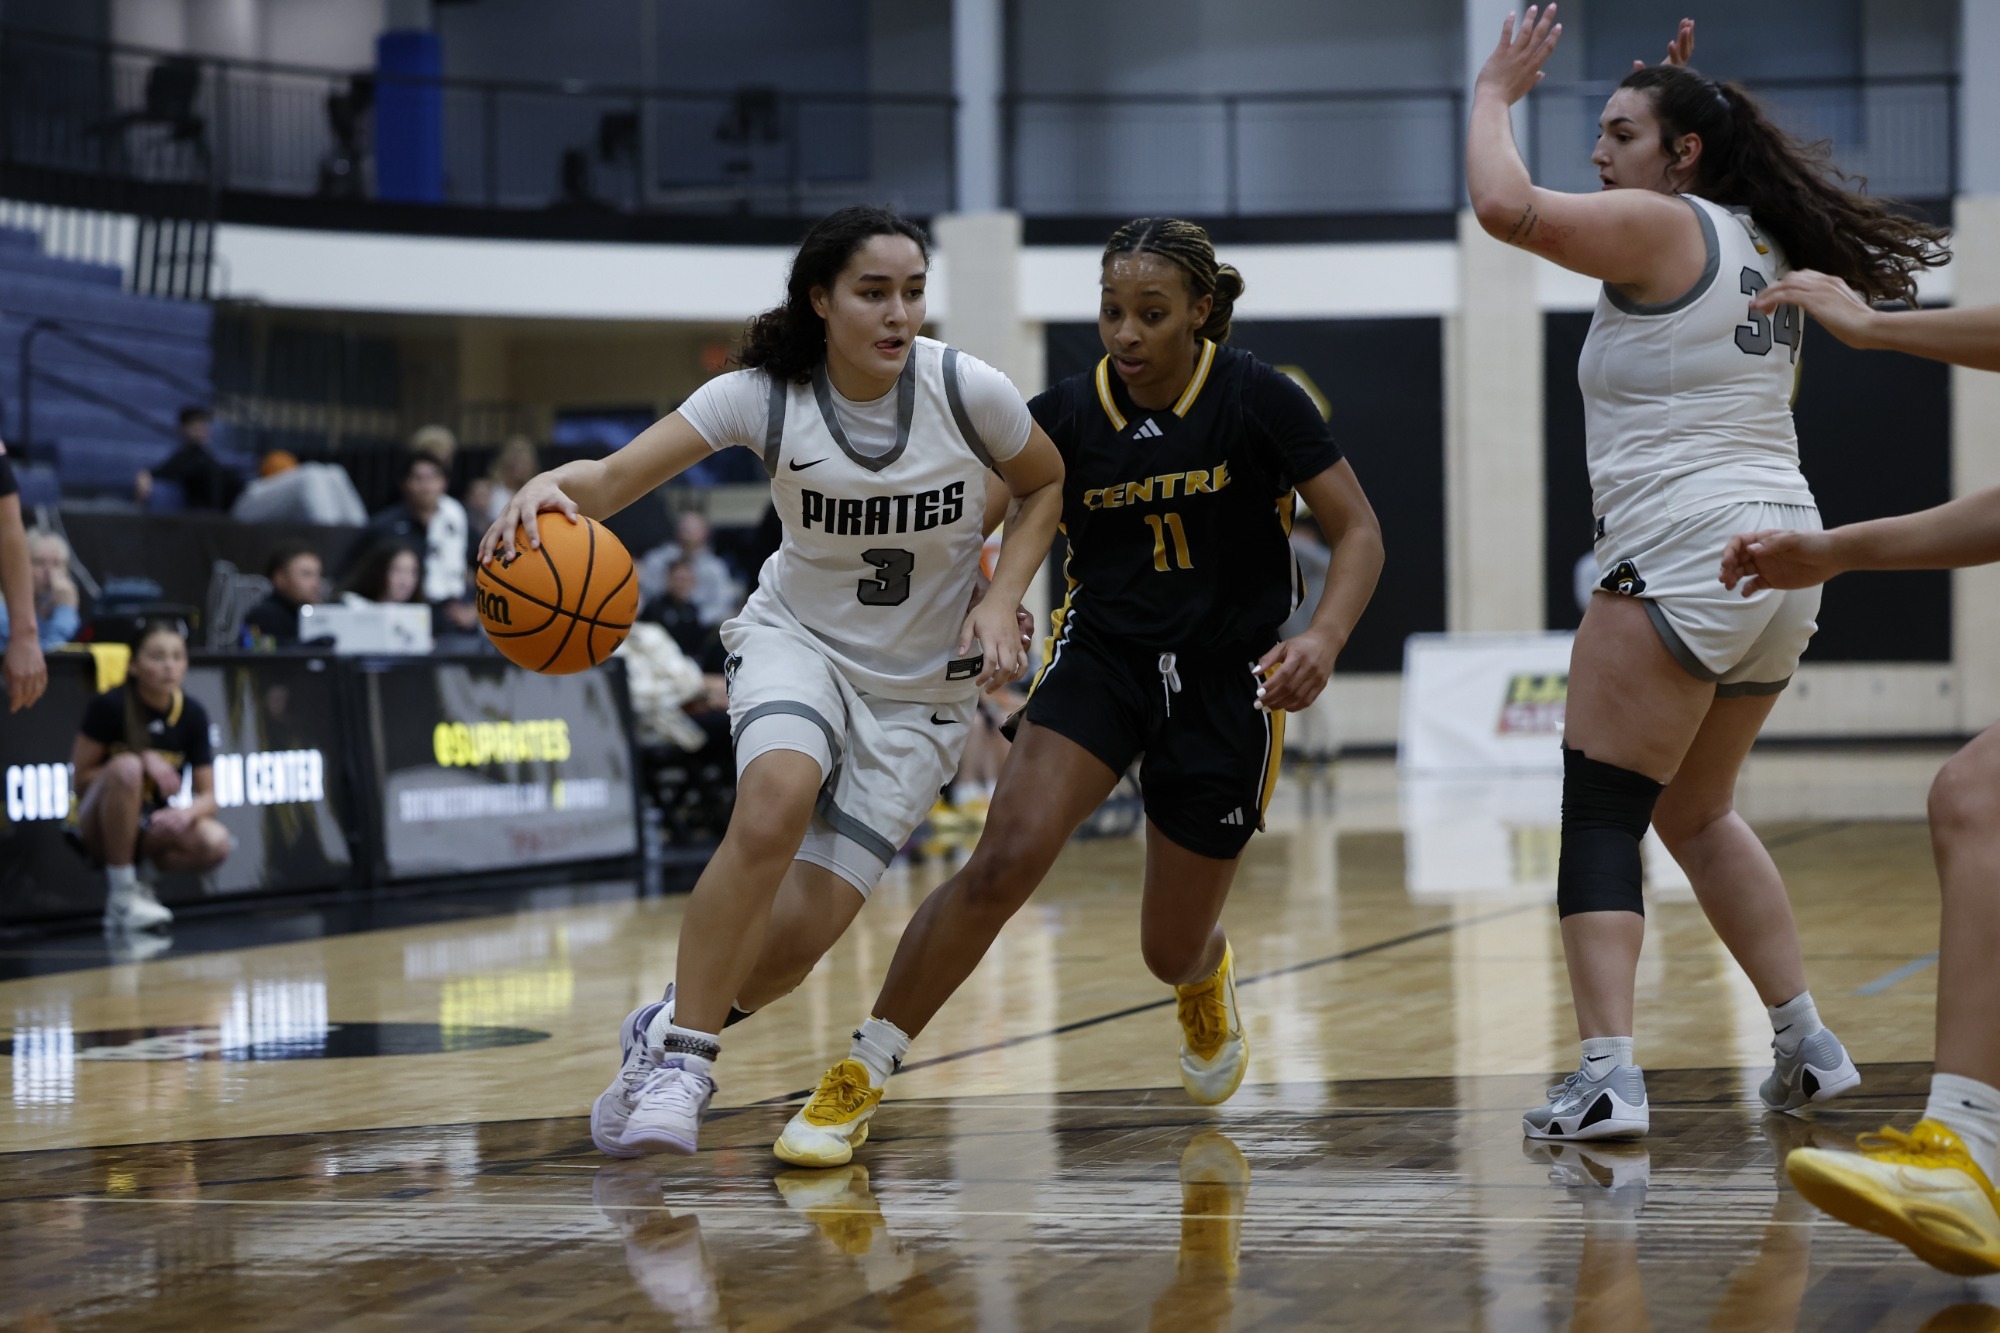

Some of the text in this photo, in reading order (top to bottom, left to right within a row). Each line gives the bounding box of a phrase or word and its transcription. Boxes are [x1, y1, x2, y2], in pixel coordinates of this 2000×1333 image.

[1734, 266, 1801, 365] 34
[801, 480, 966, 536] PIRATES
[1083, 459, 1232, 511] CENTRE
[1144, 512, 1195, 572] 11
[856, 548, 915, 607] 3
[245, 748, 324, 806] CENTER
